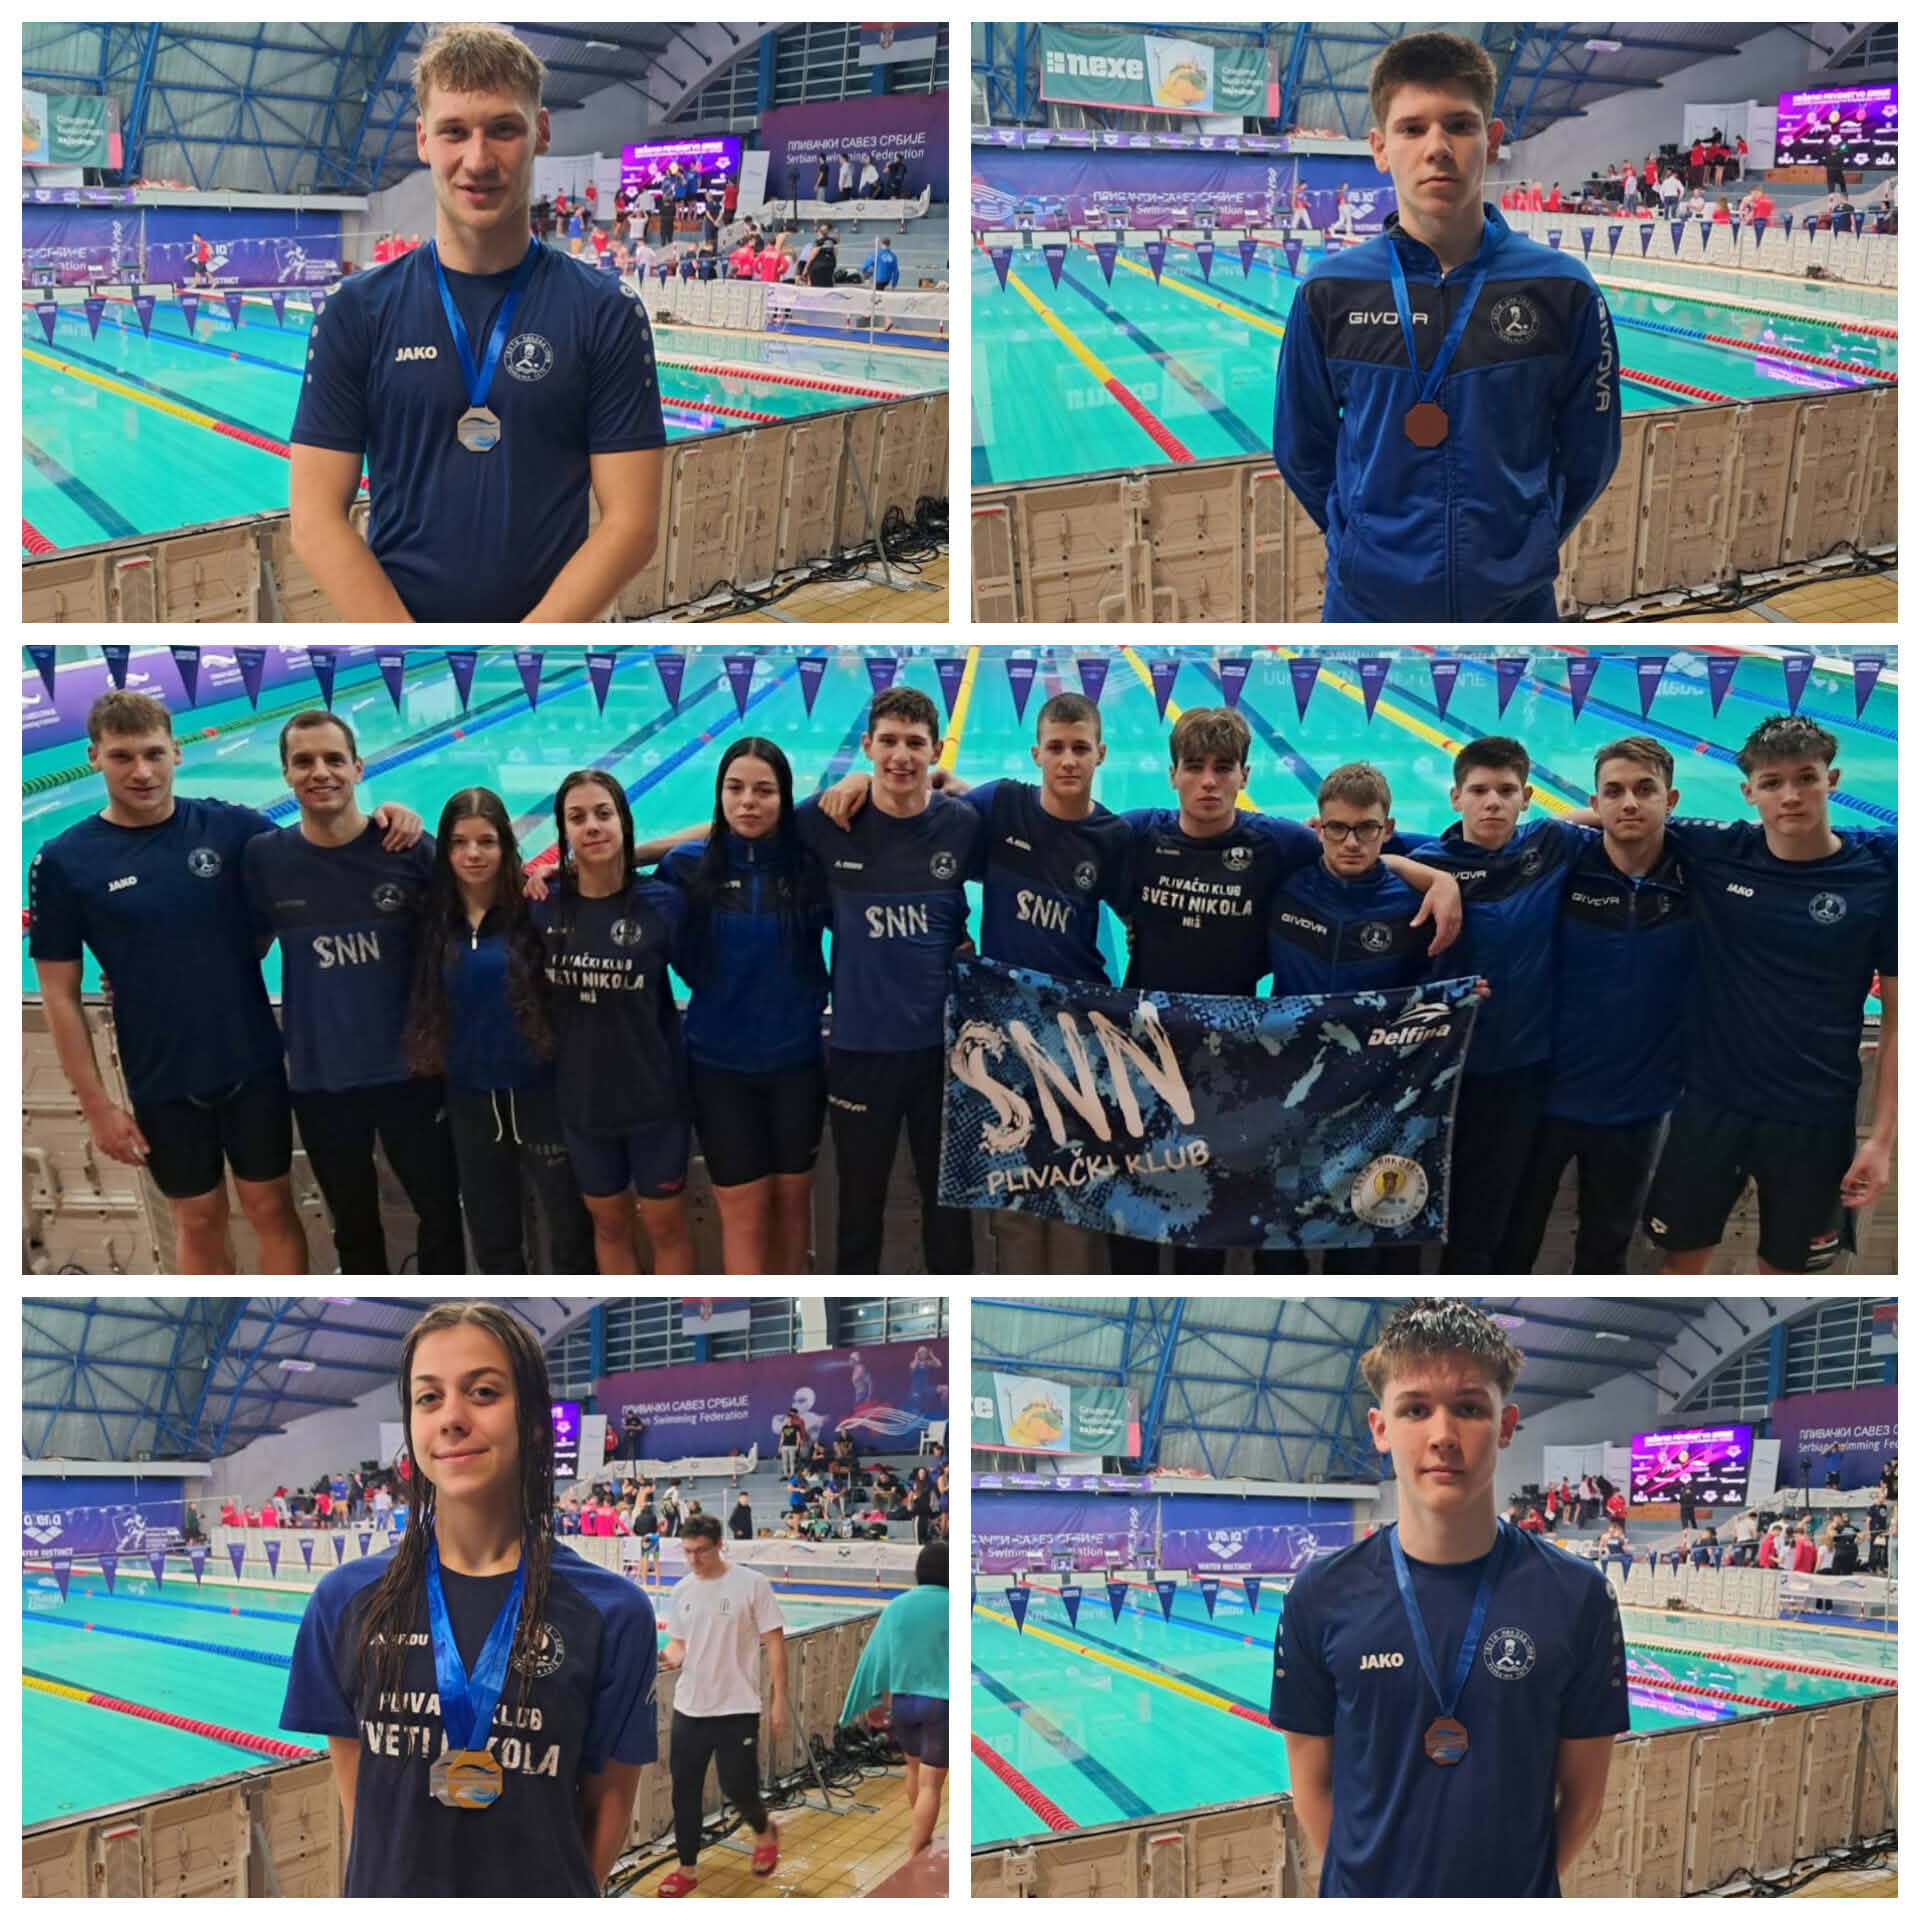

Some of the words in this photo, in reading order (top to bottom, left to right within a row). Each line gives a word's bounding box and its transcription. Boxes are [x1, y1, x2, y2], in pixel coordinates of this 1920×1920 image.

[1066, 53, 1144, 80] nexe
[841, 135, 877, 148] САВЕЗ
[871, 148, 925, 162] Federtion
[1349, 311, 1428, 325] GIVOA
[395, 346, 438, 363] JAKO
[108, 874, 138, 893] JAKO
[1159, 874, 1210, 895] PLIVAČKI
[1211, 883, 1242, 897] KLUB
[1726, 882, 1754, 899] JAKO
[1016, 889, 1072, 935] SNN
[1142, 886, 1186, 909] SVETI
[1188, 896, 1253, 916] NIKOLA
[865, 904, 929, 939] SNN
[312, 931, 380, 968] SNN
[582, 971, 645, 990] NIKOLA
[1368, 1024, 1450, 1047] Delfina
[951, 1001, 1195, 1153] SNN
[987, 1149, 1116, 1195] PLIVAČKI
[1125, 1140, 1209, 1174] KLUB
[1359, 1652, 1404, 1670] JAKO
[379, 1691, 440, 1716] PLIVA
[360, 1720, 430, 1759] VETI
